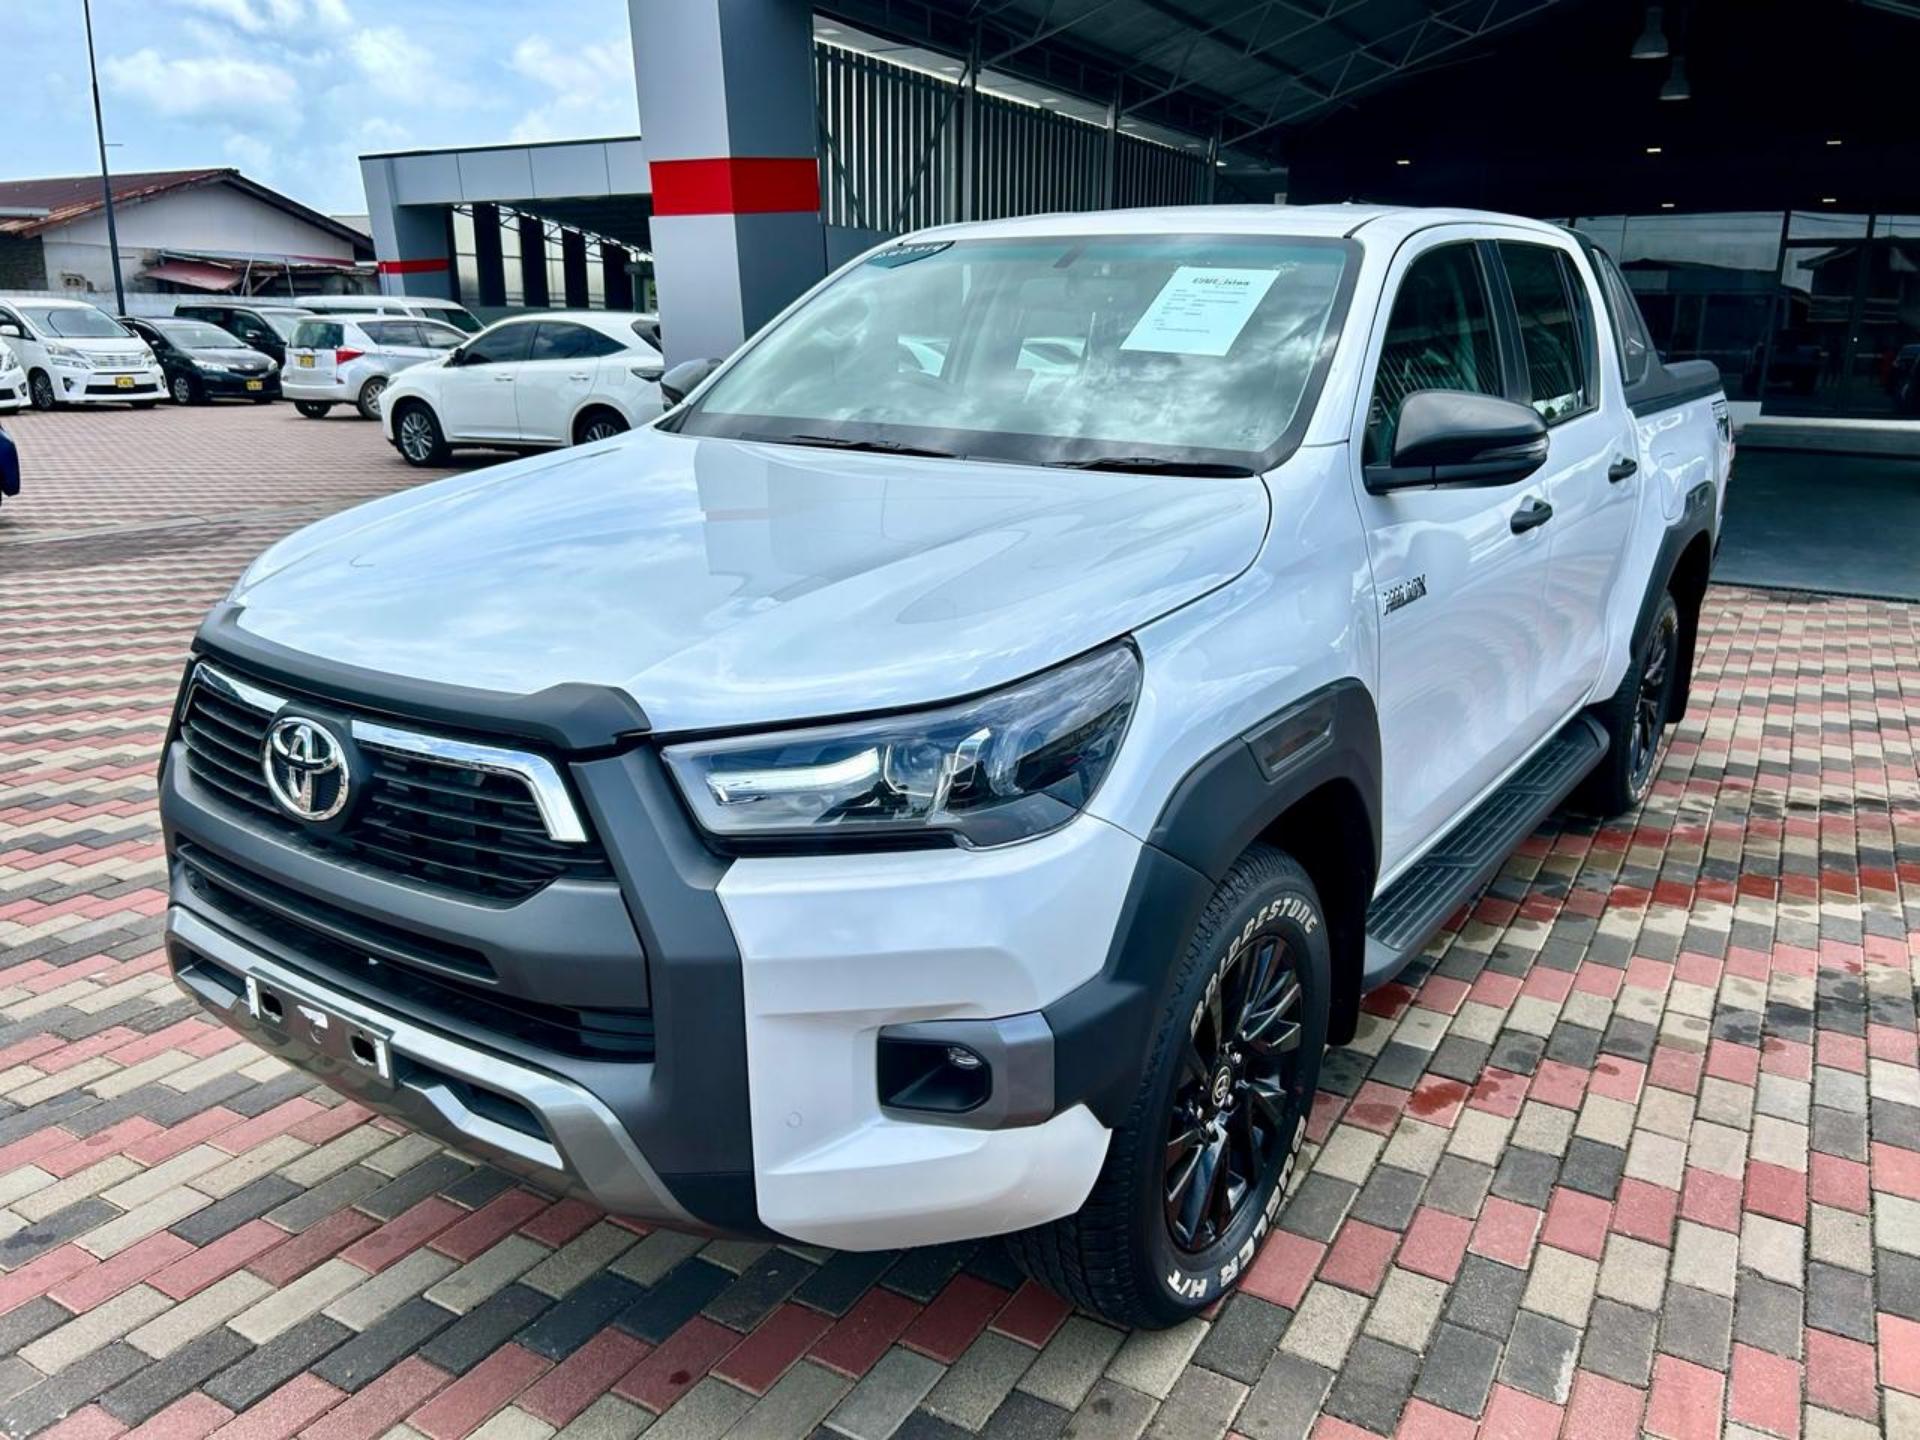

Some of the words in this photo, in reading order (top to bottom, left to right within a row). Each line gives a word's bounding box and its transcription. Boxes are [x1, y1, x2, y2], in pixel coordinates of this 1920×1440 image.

[1191, 898, 1319, 1040] BRIDGESTONE
[1220, 1115, 1306, 1287] DUELER
[1167, 1269, 1207, 1299] H/T
